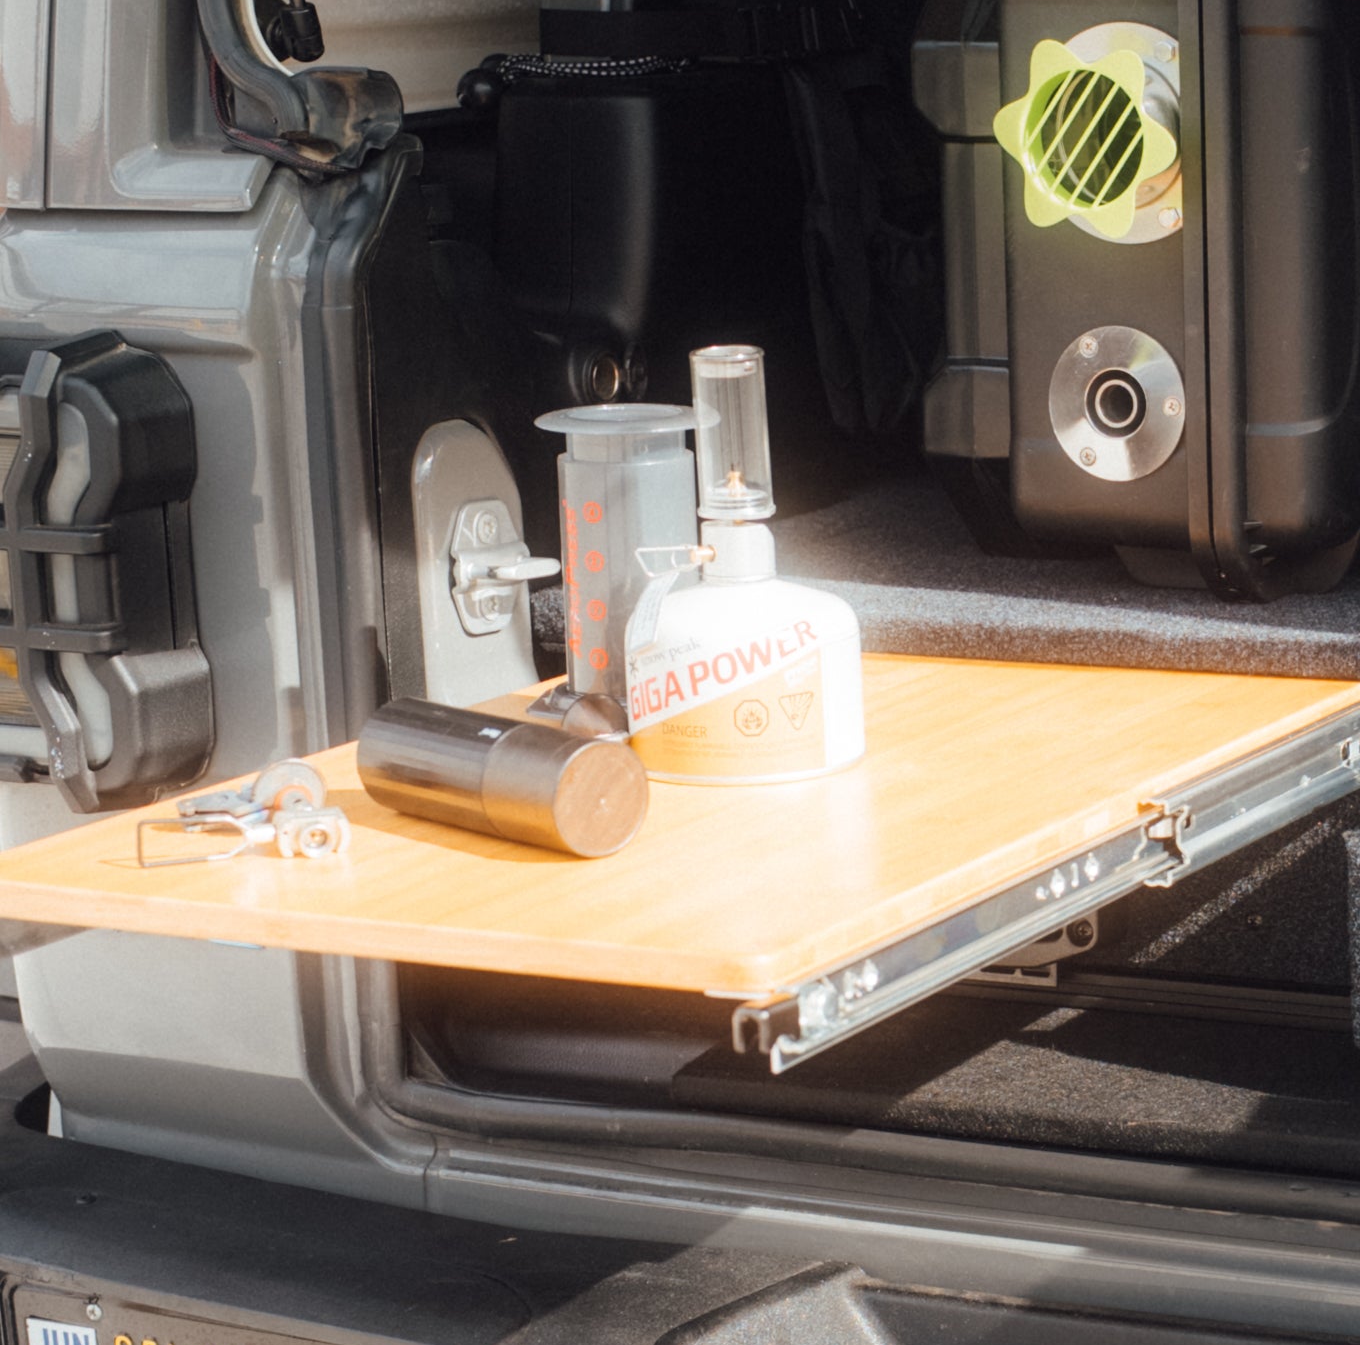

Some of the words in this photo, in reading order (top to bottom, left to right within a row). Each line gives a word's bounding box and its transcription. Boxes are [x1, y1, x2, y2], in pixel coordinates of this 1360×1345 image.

[668, 638, 702, 660] peak
[630, 670, 686, 721] GIGA
[688, 620, 818, 697] POWER
[661, 722, 708, 739] DANGER
